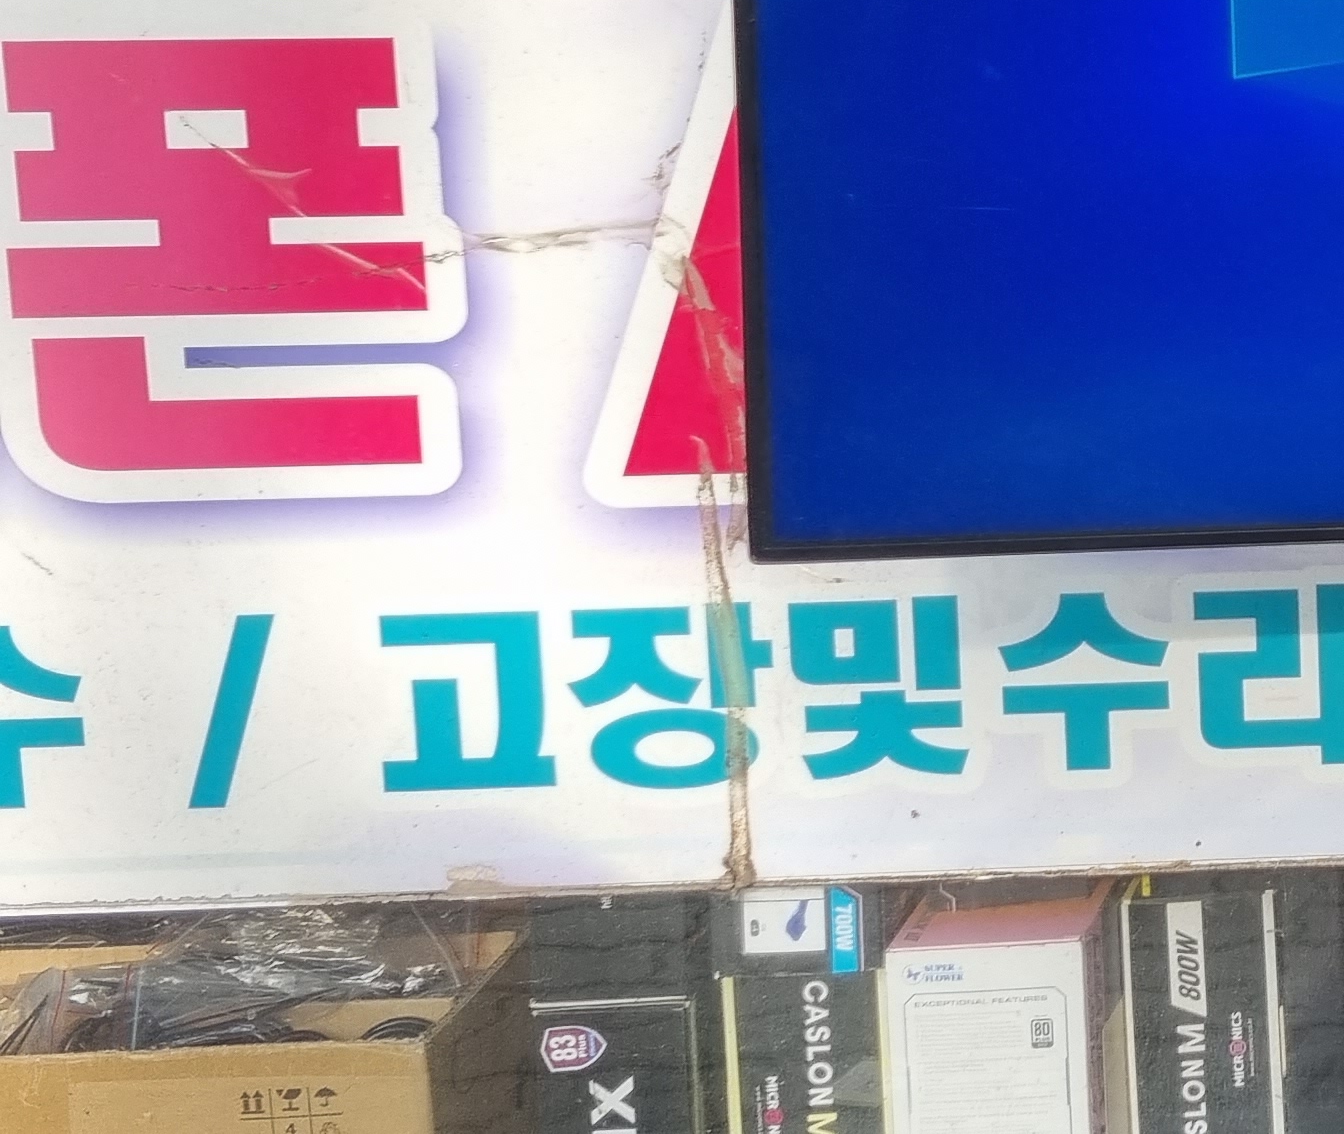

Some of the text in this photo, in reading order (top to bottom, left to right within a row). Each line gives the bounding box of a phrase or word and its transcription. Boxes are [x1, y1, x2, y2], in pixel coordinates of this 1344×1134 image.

[2, 37, 428, 471] 폰
[834, 905, 854, 951] 700W
[924, 963, 955, 972] SUPER
[924, 973, 964, 982] FLOWER
[1175, 929, 1201, 1002] 800W
[914, 994, 1048, 1009] EXCEPTIONAL FEATURES
[803, 980, 835, 1108] CASLON
[1034, 1021, 1050, 1037] 80
[1175, 1022, 1206, 1054] M
[550, 1034, 578, 1062] 83
[1229, 1011, 1247, 1087] MICRONICS
